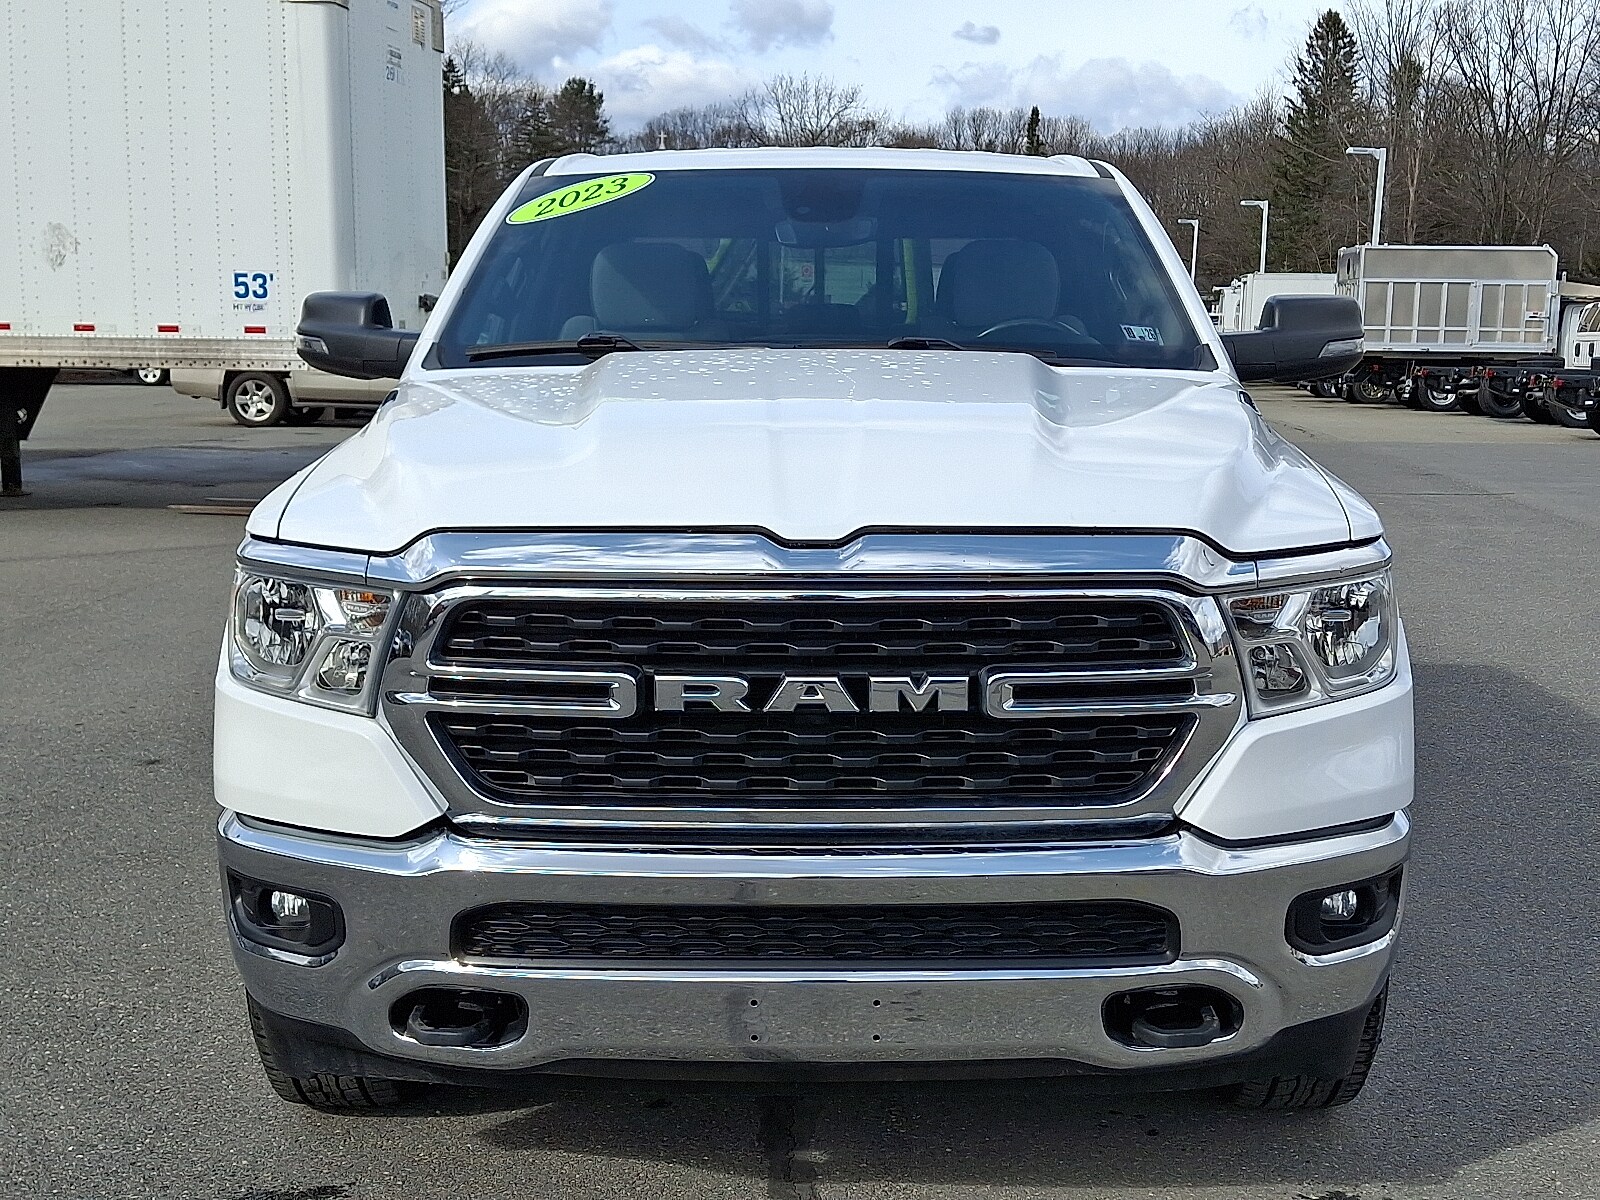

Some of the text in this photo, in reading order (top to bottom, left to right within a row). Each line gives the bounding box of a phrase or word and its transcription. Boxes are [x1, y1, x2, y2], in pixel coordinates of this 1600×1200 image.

[534, 177, 629, 218] 2023
[233, 272, 274, 299] 53'
[654, 673, 969, 713] RAM
